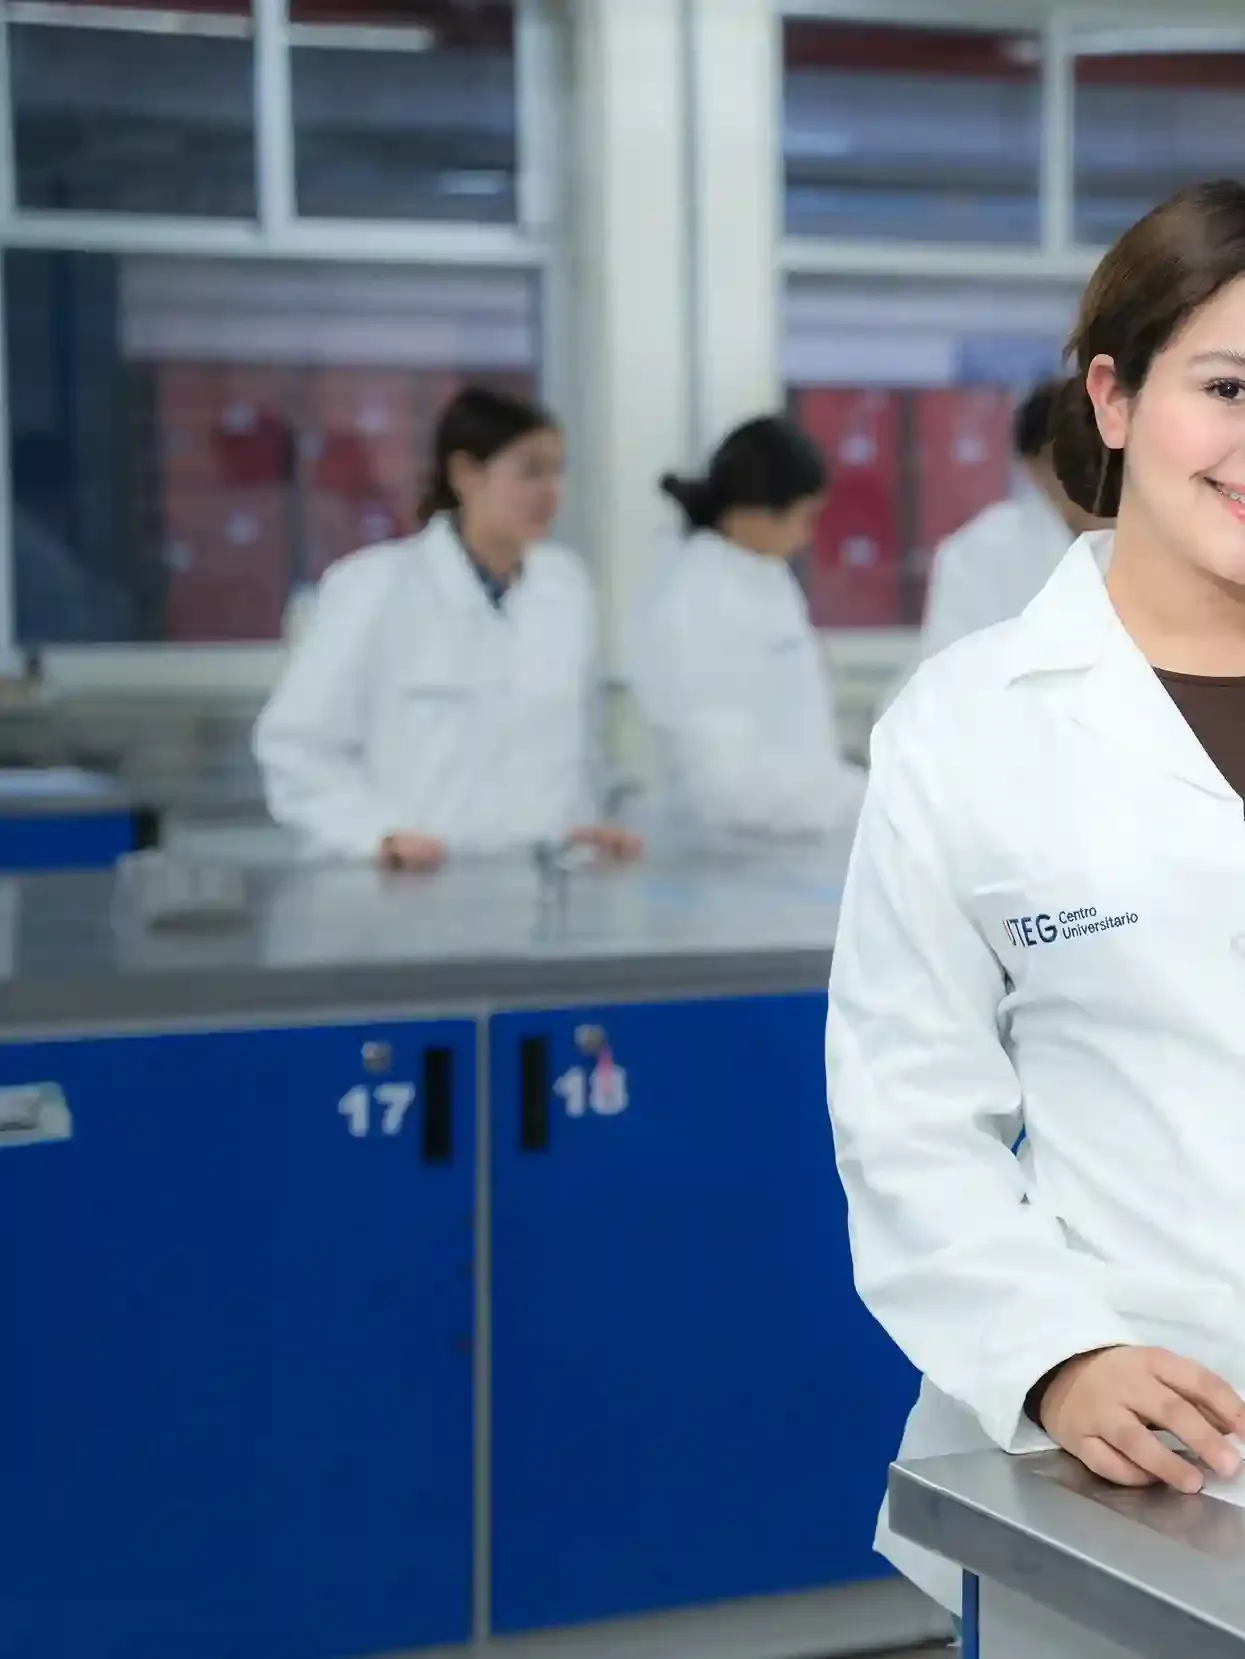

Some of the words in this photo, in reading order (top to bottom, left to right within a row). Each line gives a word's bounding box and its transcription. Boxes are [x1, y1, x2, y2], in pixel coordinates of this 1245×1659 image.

[1058, 906, 1097, 924] Centro
[1062, 912, 1139, 940] Universitario
[337, 1082, 416, 1138] 17
